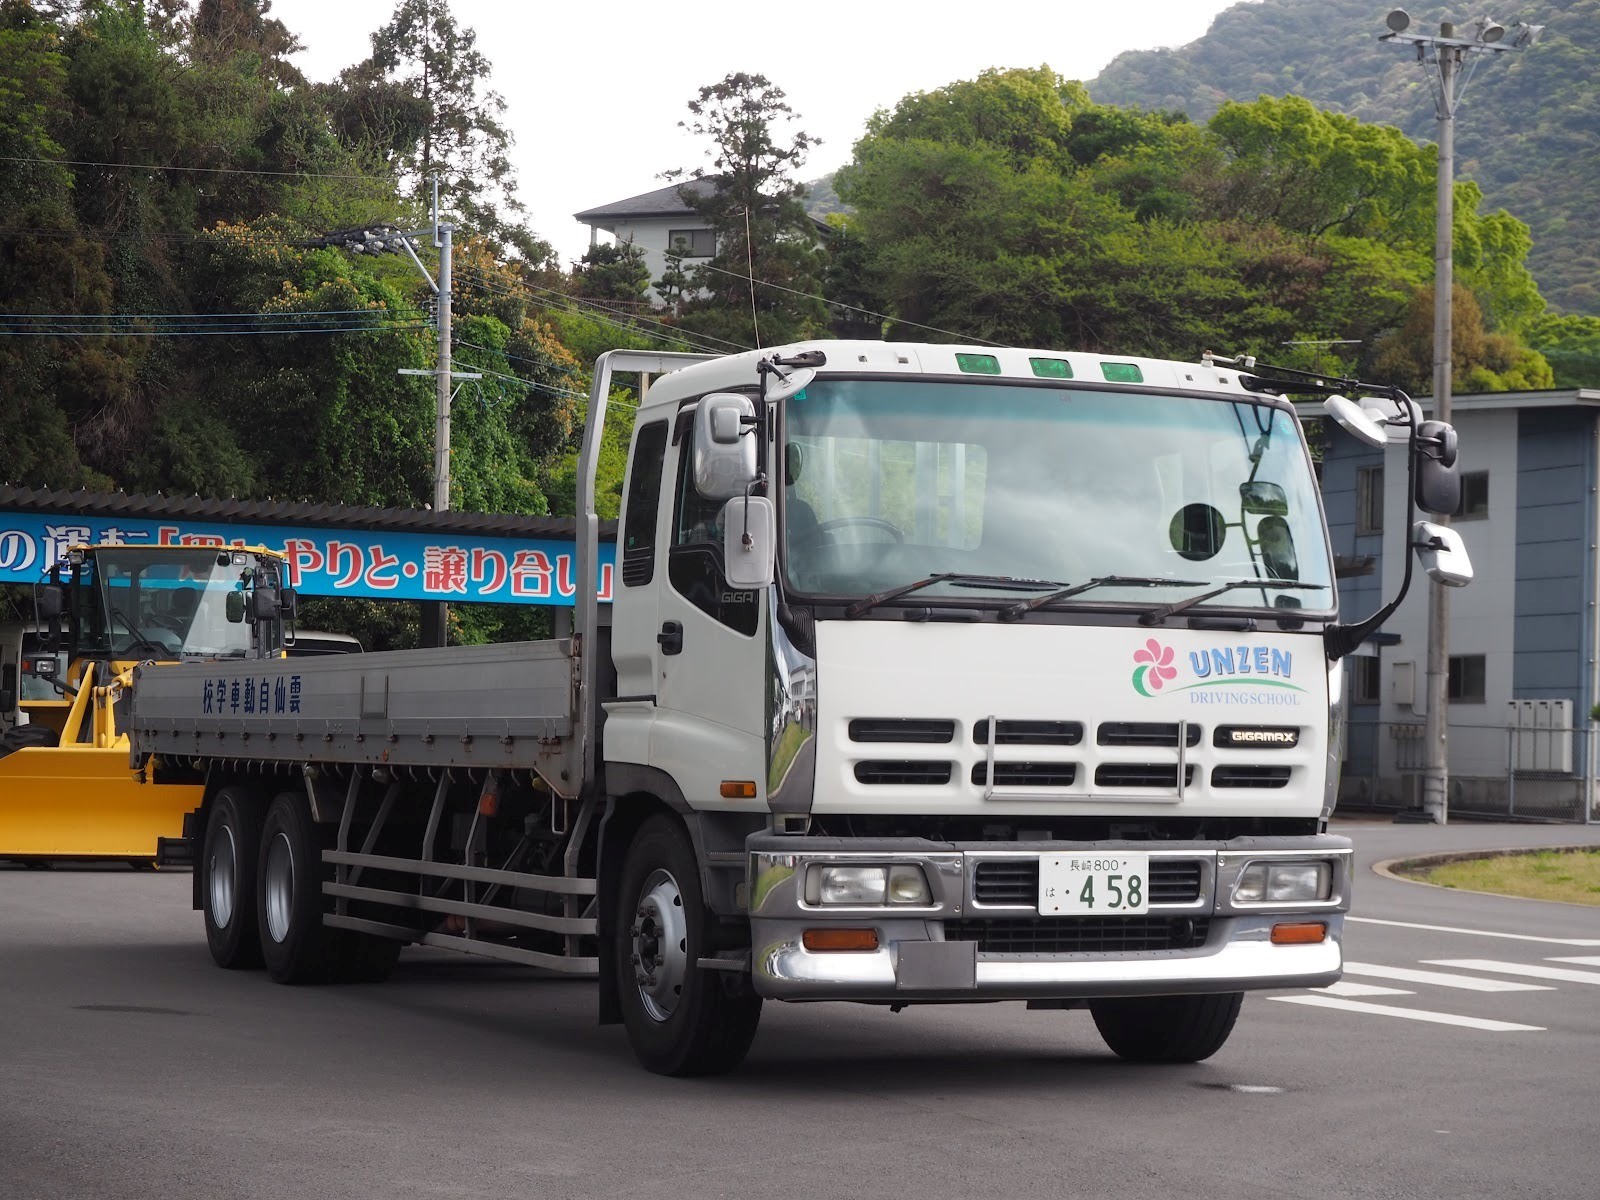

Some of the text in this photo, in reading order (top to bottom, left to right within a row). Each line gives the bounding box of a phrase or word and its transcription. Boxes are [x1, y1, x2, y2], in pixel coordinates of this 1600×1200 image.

[721, 592, 753, 603] GIGA
[1189, 646, 1292, 678] UNZEN
[1232, 731, 1294, 742] GIGAMAX
